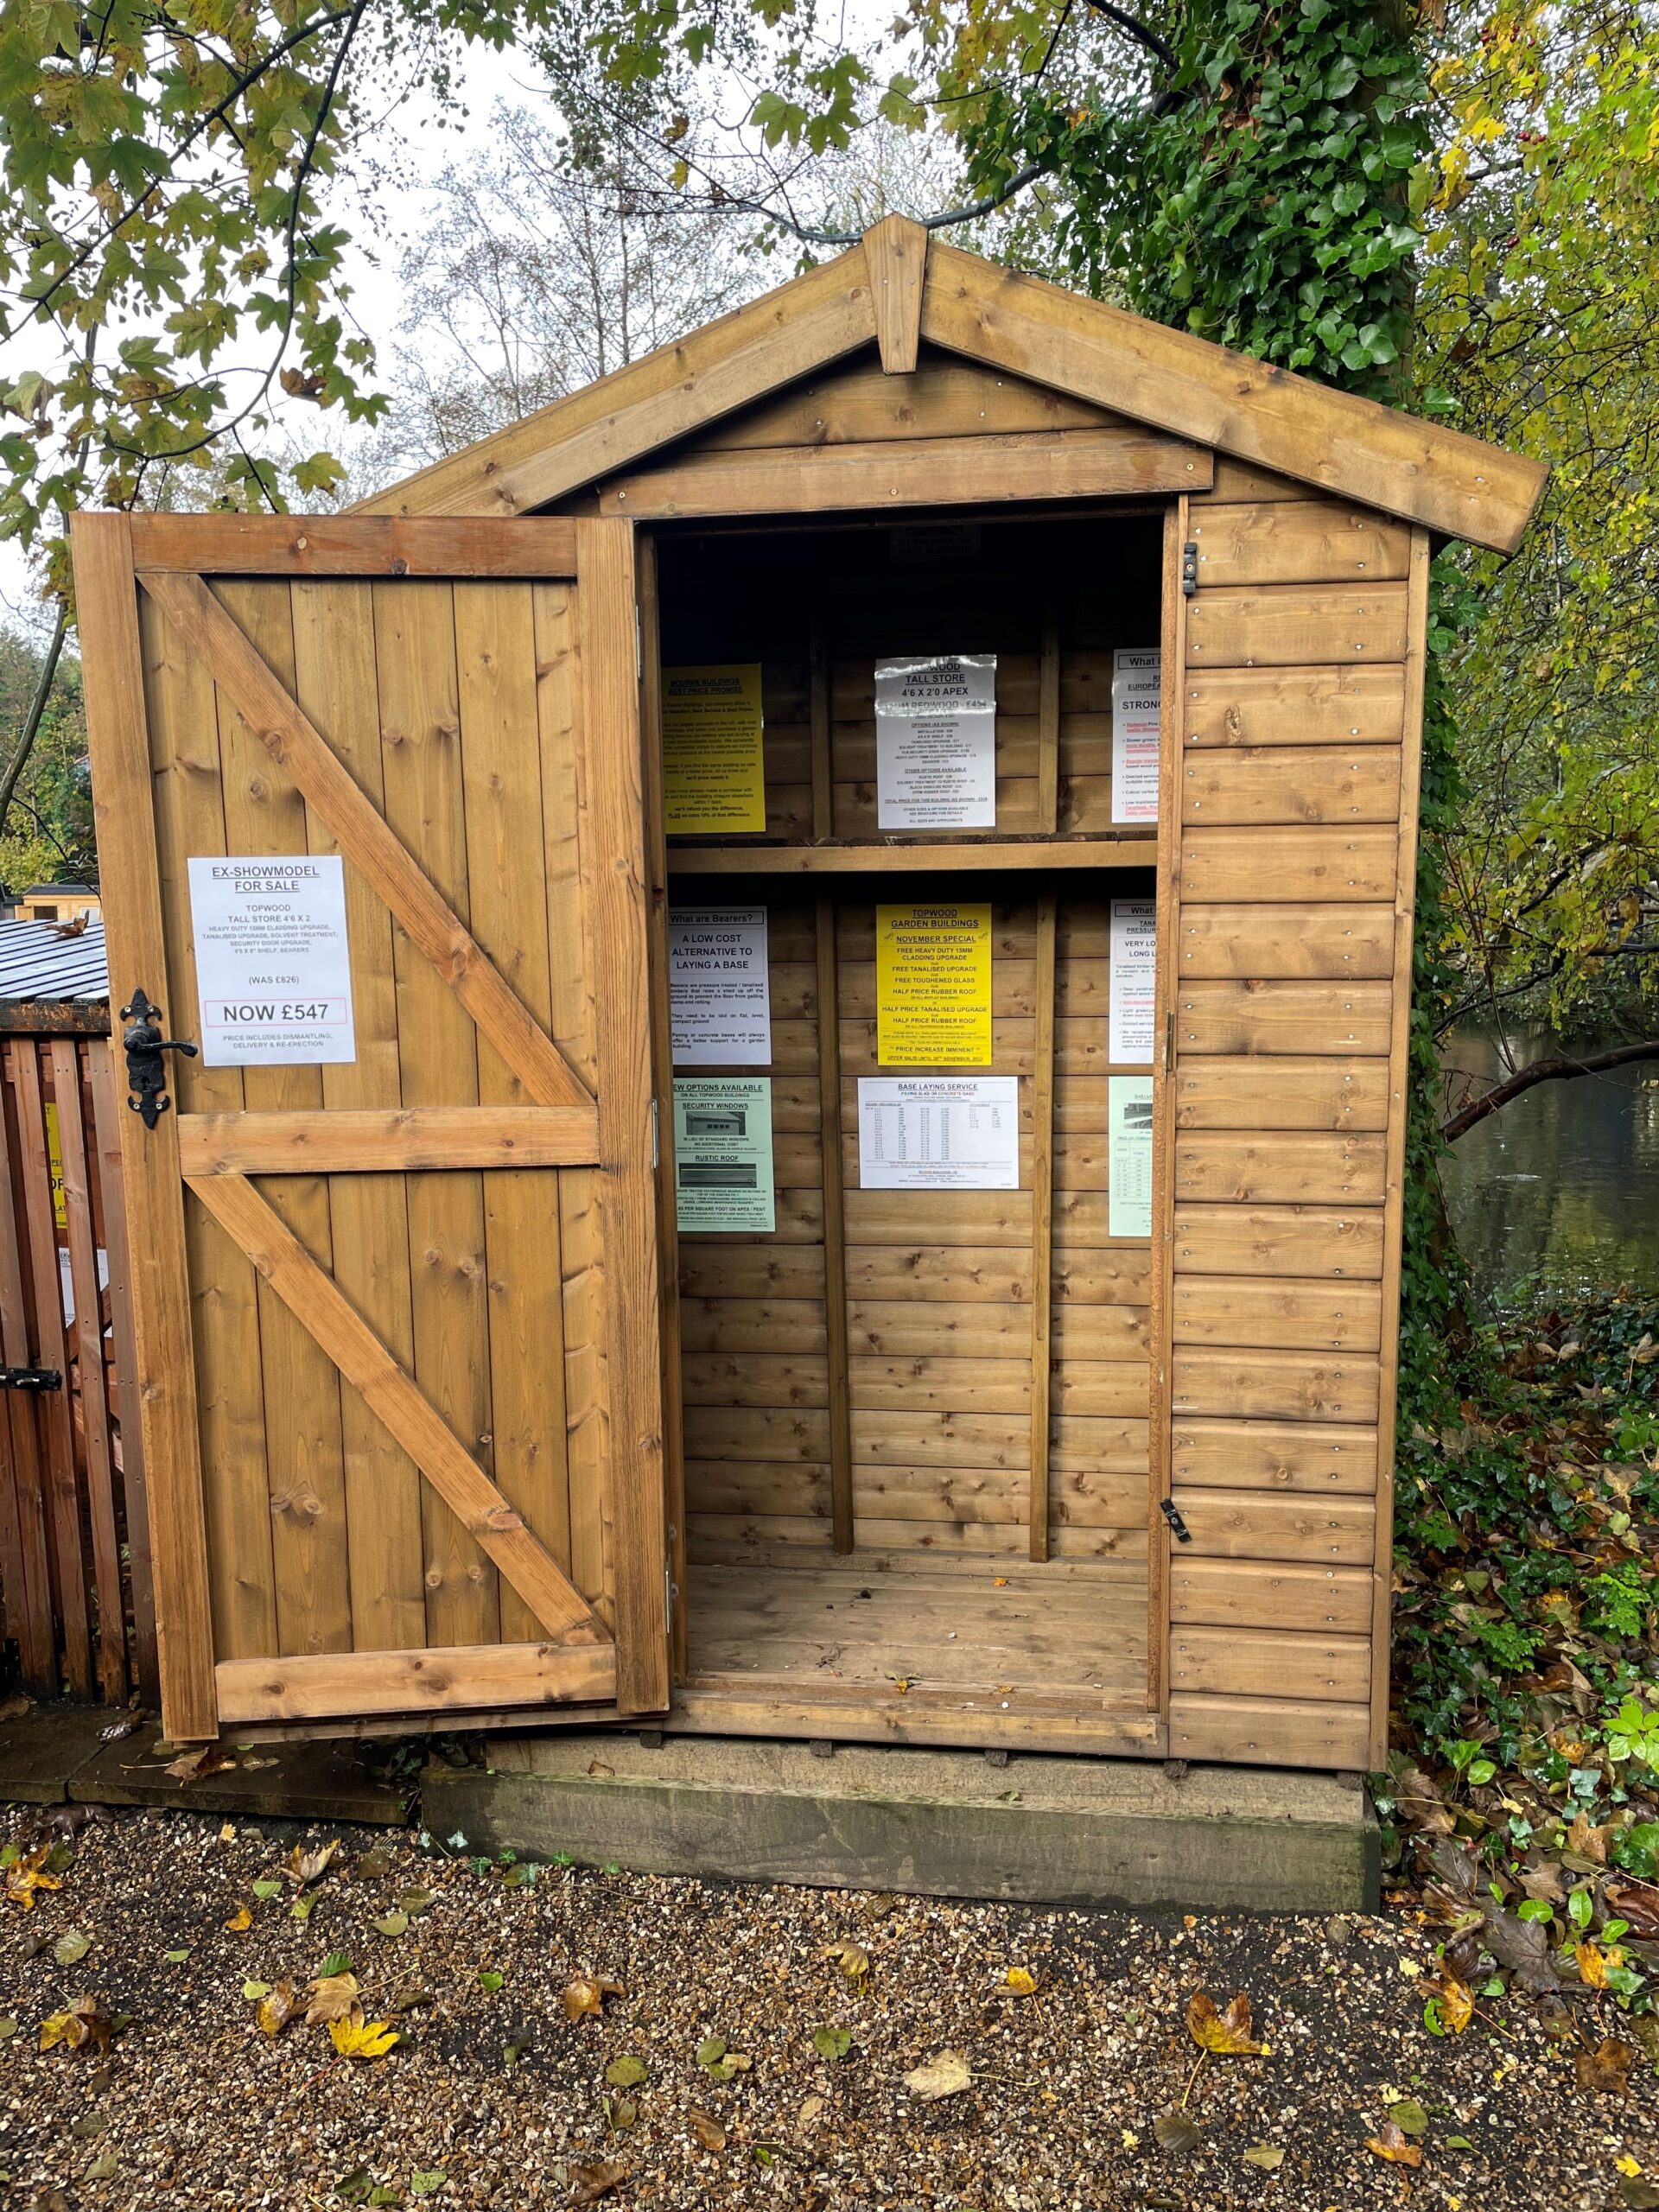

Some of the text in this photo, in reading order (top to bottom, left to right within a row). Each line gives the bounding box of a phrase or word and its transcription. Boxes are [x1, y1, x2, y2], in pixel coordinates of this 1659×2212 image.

[1129, 658, 1154, 666] What
[933, 674, 964, 683] STORE
[213, 866, 321, 878] EX-SHOWMODEL
[235, 880, 300, 892] FOR SALE
[249, 976, 299, 986] (WAS £826)
[224, 1004, 328, 1021] NOW £547
